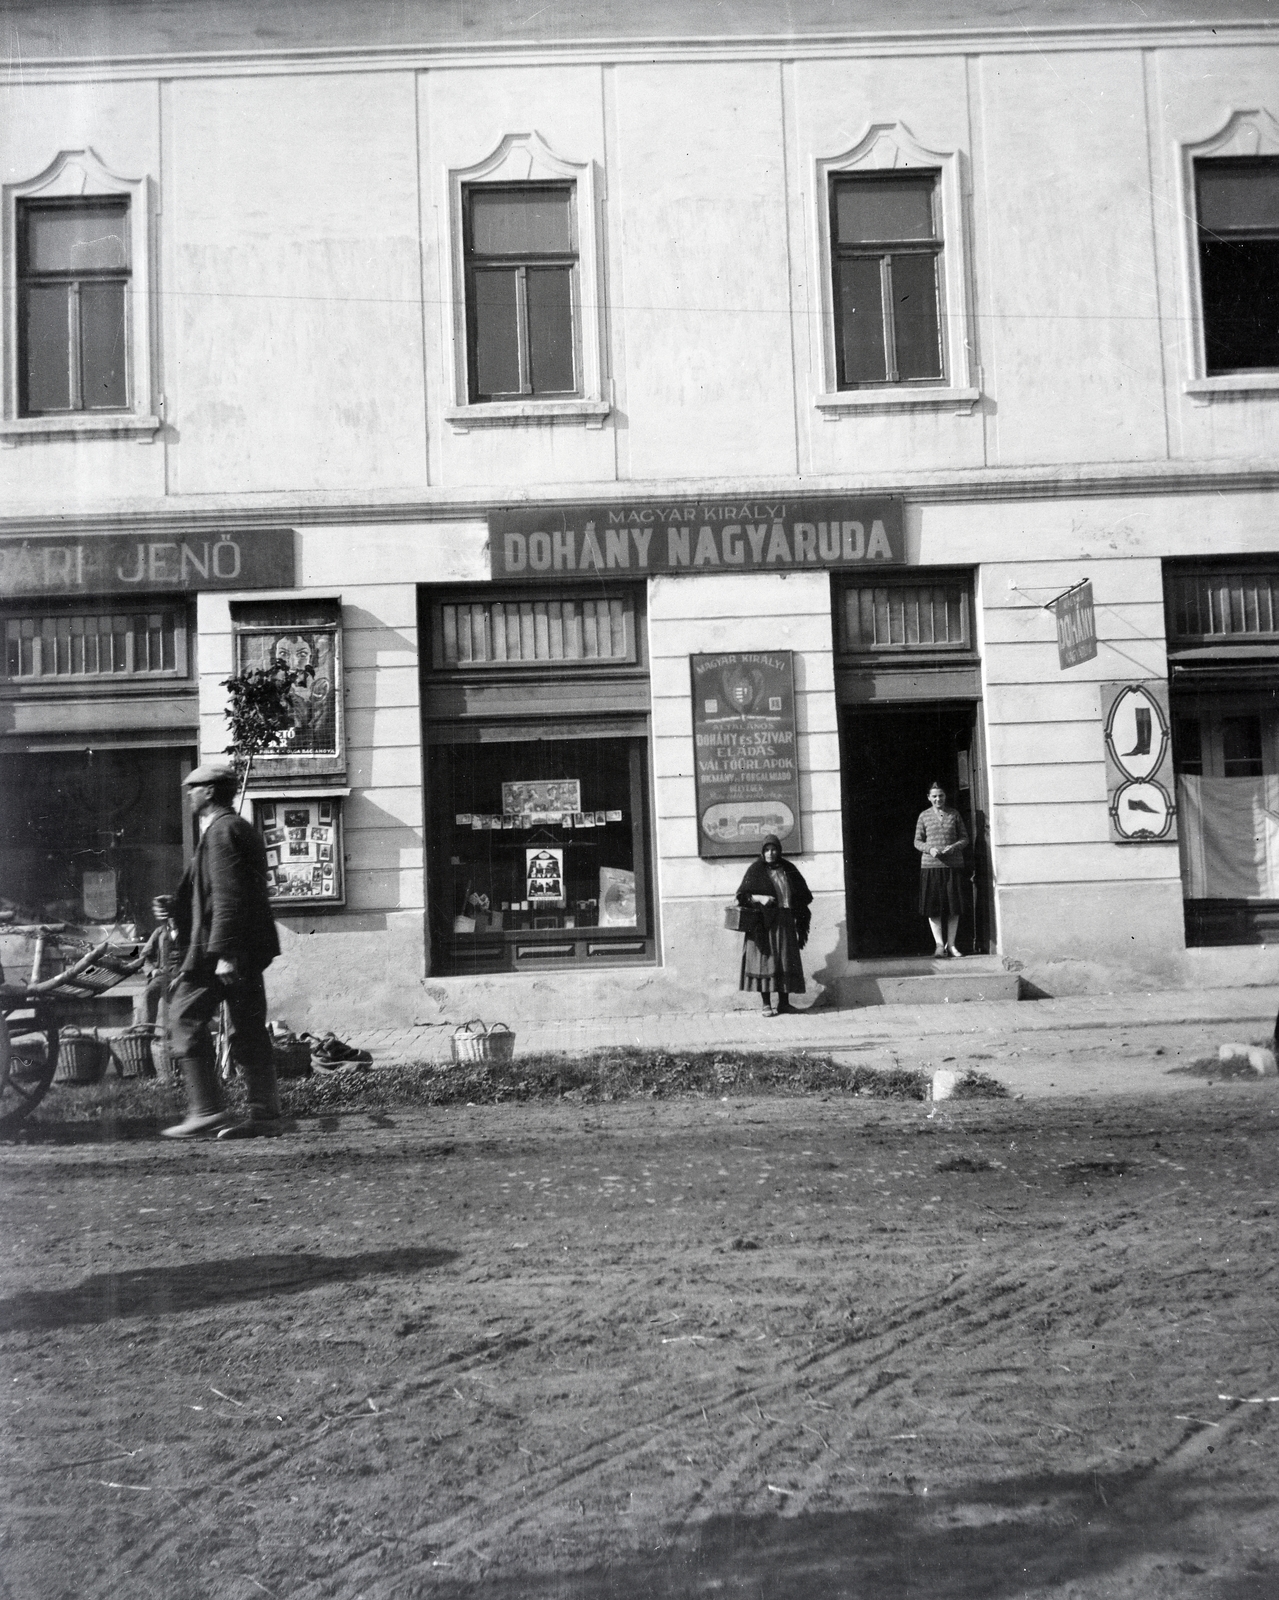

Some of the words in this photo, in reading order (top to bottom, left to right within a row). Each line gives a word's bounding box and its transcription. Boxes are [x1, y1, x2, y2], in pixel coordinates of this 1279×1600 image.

[608, 508, 696, 524] MAGYAR
[704, 503, 786, 521] KIRÁLYI
[503, 521, 653, 572] DOHÁNY
[667, 517, 893, 567] NAGYÁRUDA
[696, 655, 737, 674] MAGYAR
[696, 731, 738, 747] DOHÁNY
[754, 731, 793, 745] SZIVAR
